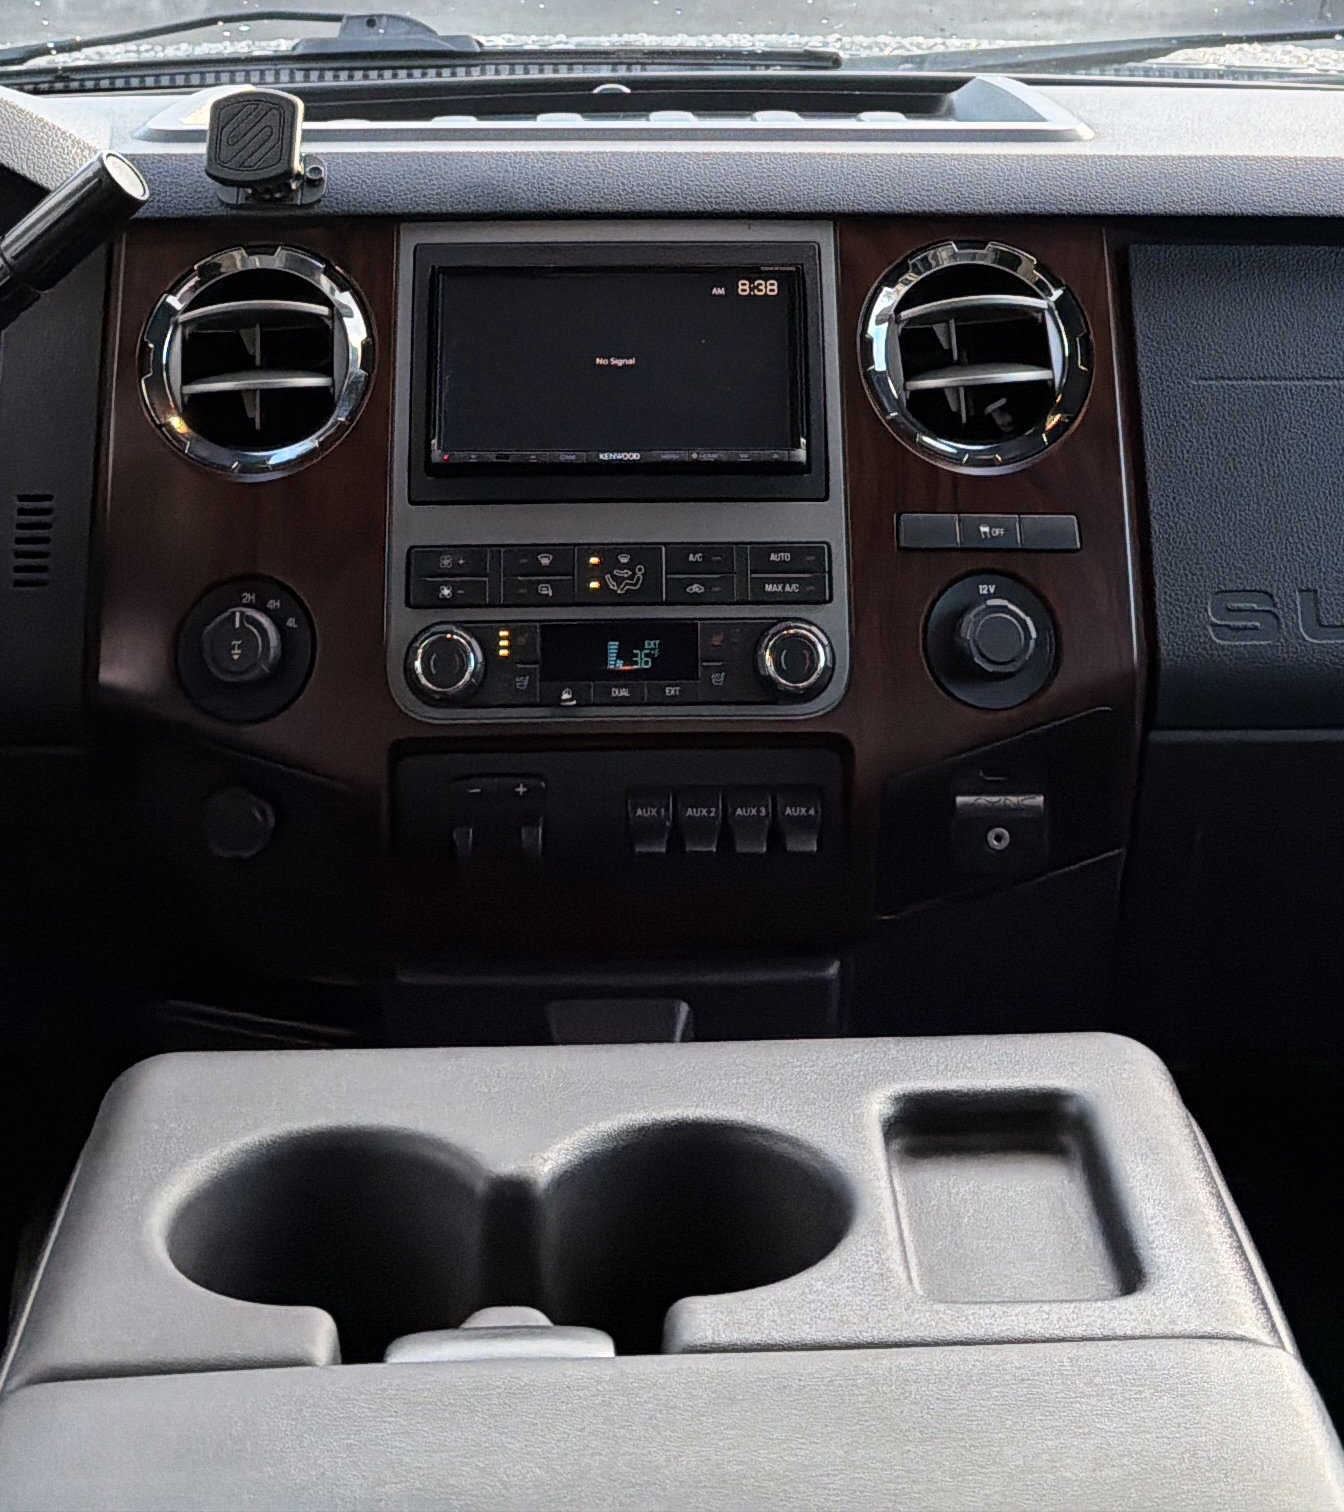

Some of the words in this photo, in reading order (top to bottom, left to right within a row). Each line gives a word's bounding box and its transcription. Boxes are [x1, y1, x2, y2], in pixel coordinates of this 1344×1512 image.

[712, 287, 726, 295] AM
[738, 280, 778, 296] 8:38
[596, 357, 609, 365] No
[610, 357, 636, 367] Signal
[599, 452, 640, 461] KENWOOD
[991, 528, 1006, 537] OFF
[688, 553, 703, 561] A/C
[769, 553, 791, 561] AUTO
[764, 583, 783, 592] MAX
[784, 583, 800, 592] A/C
[241, 592, 256, 604] 2H
[266, 599, 281, 609] 4H
[286, 617, 298, 628] 4L
[644, 640, 660, 648] EXT
[611, 688, 631, 697] DUAL
[665, 687, 680, 696] EXT
[635, 807, 658, 817] AUX
[686, 807, 708, 817] AUX
[735, 807, 757, 816] AUX
[784, 806, 806, 816] AUX
